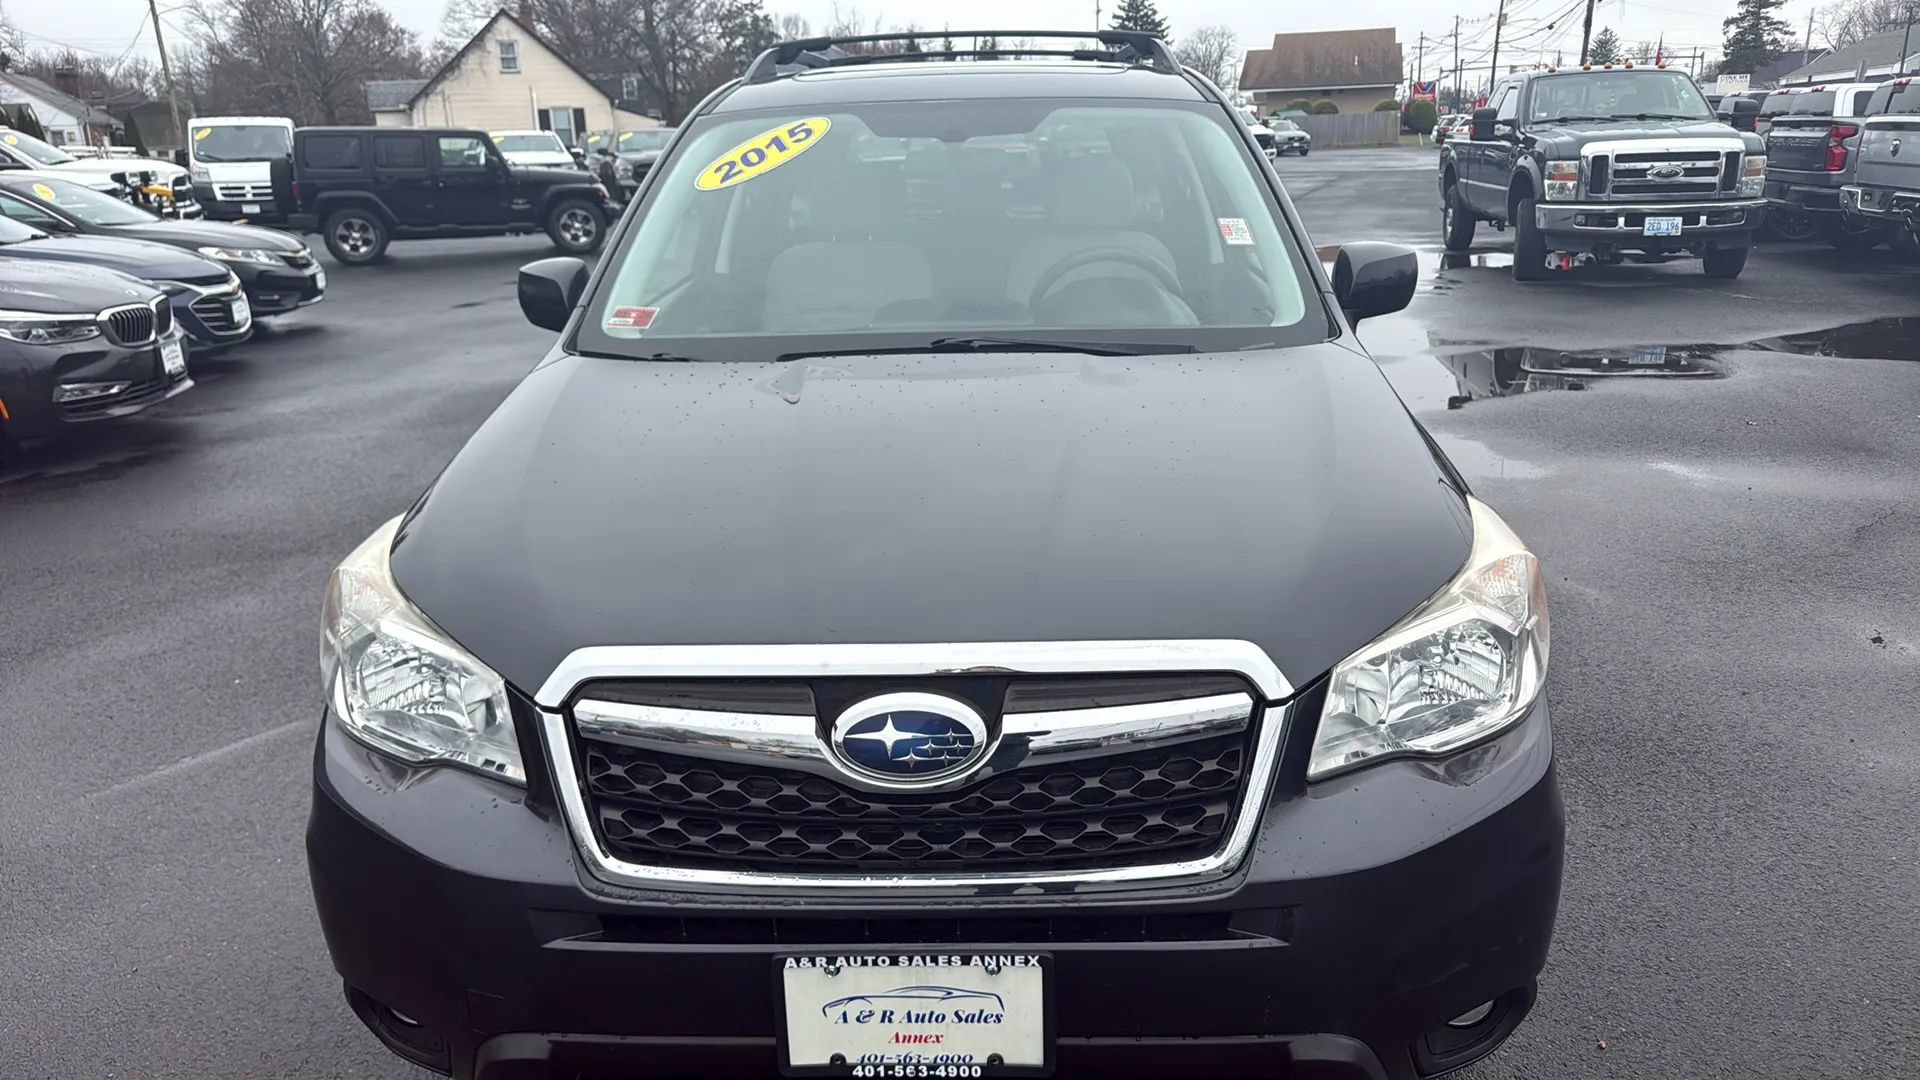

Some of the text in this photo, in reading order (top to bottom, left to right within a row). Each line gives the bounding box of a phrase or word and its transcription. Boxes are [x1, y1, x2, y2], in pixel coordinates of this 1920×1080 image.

[714, 122, 814, 184] 2015
[785, 955, 1040, 968] A&R AUTO SALES ANNEX
[835, 1009, 1003, 1024] A & R Auto Sales
[889, 1031, 944, 1044] Annex
[852, 1065, 982, 1077] 401-563-4900
